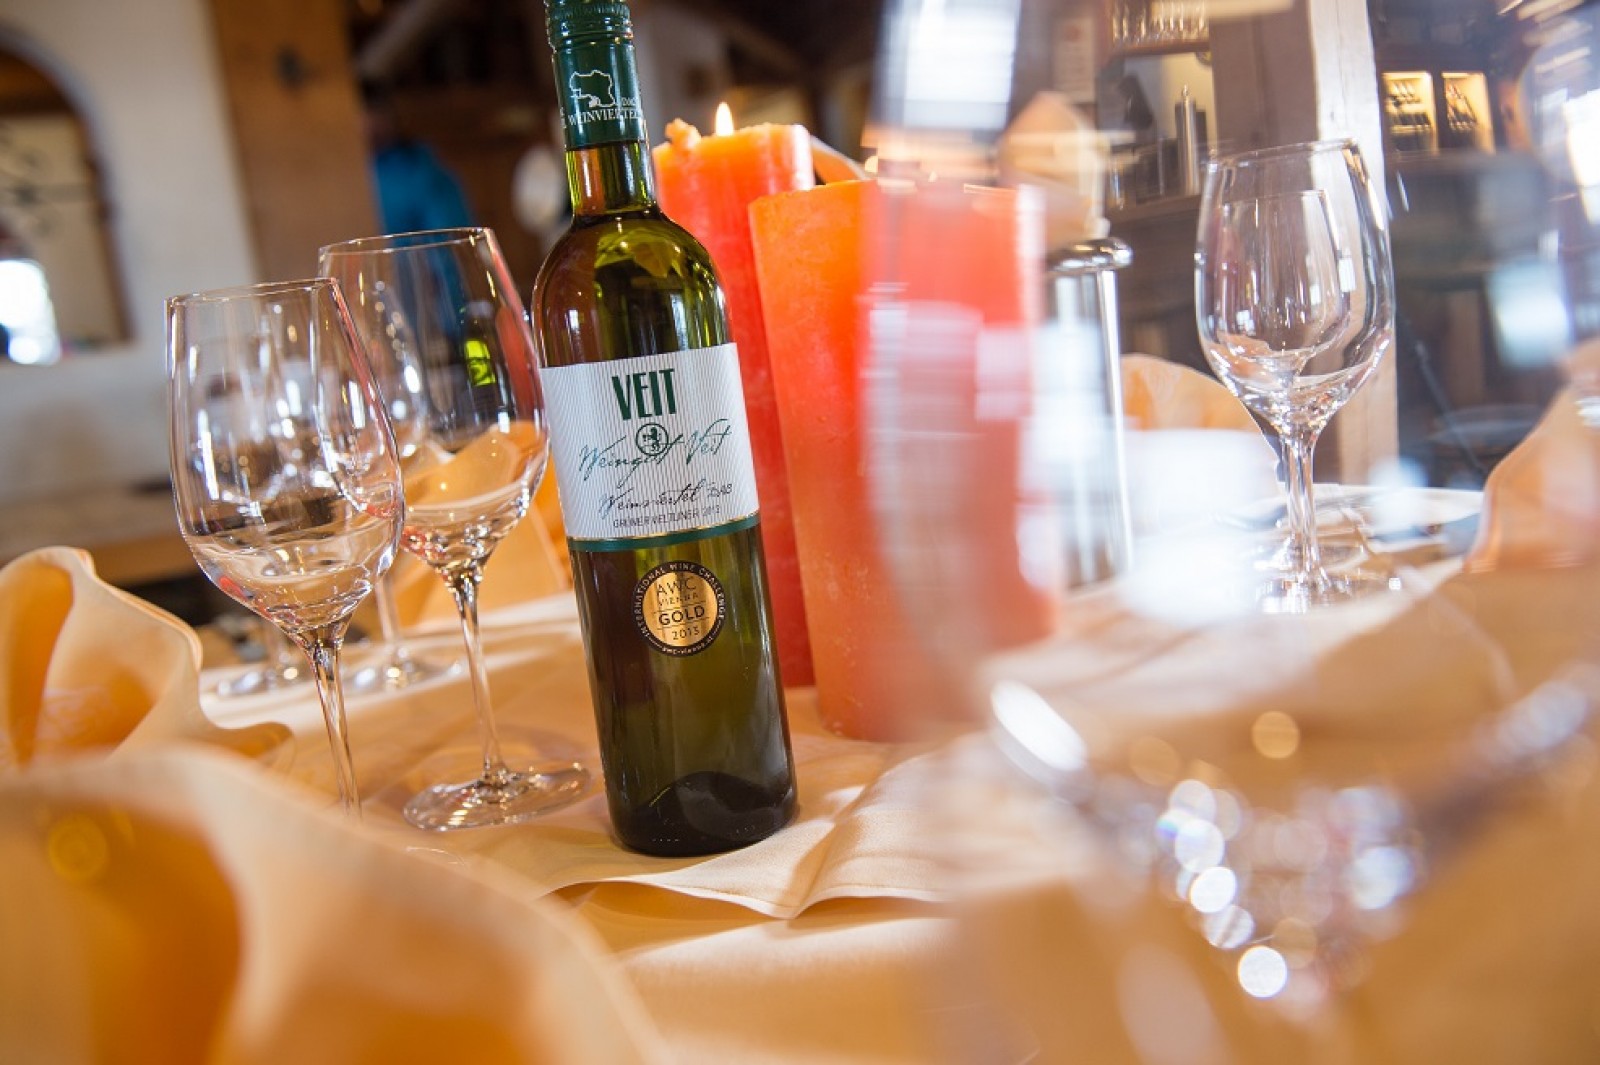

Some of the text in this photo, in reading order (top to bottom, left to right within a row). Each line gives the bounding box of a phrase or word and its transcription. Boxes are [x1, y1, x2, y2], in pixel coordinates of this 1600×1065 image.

[611, 368, 677, 421] VEIT
[685, 418, 732, 465] Veit
[634, 562, 726, 637] INTERNATIONAL WINE CHALLENGE
[656, 575, 697, 596] AWC
[658, 592, 699, 607] VIENNA
[658, 605, 705, 626] GOLD
